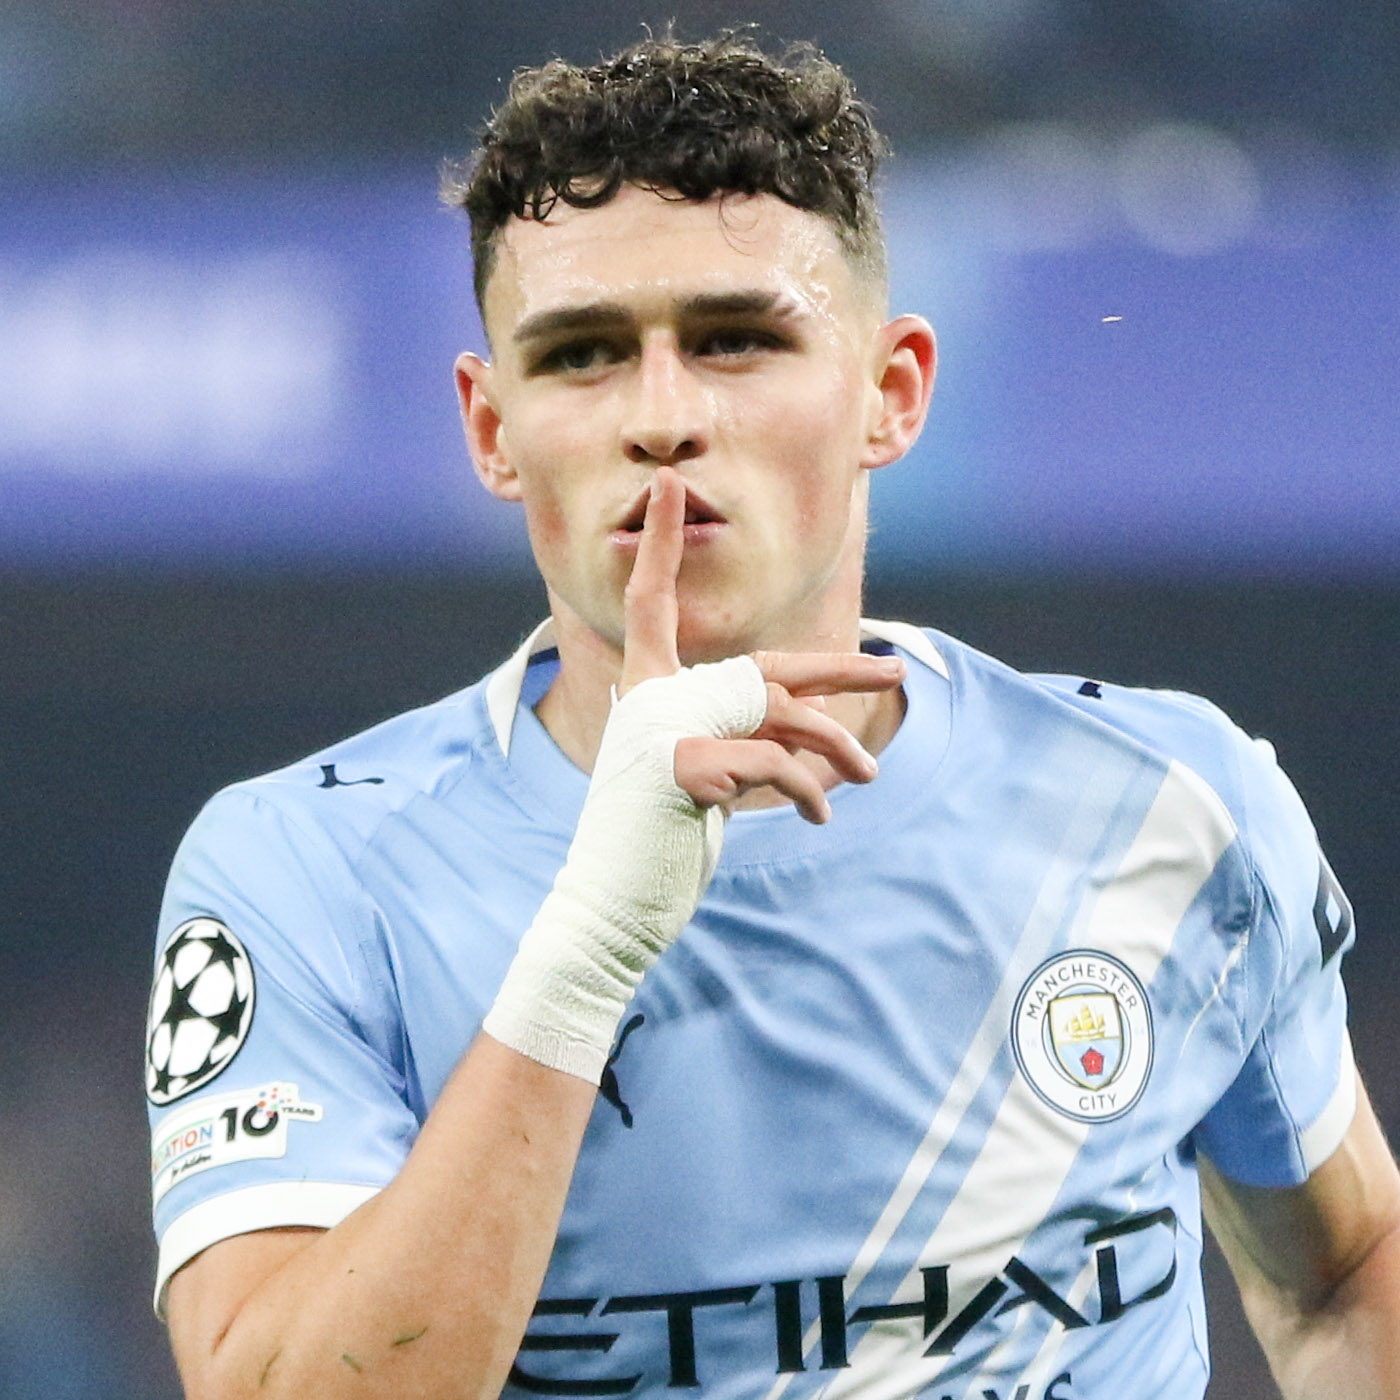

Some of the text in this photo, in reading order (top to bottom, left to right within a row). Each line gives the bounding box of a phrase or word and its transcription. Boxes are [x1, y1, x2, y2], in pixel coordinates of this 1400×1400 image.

[1026, 963, 1138, 1020] MANCHESTER
[219, 1106, 315, 1142] 10 YEARS
[1078, 1093, 1118, 1111] CITY
[506, 1207, 1178, 1396] ETIHAD
